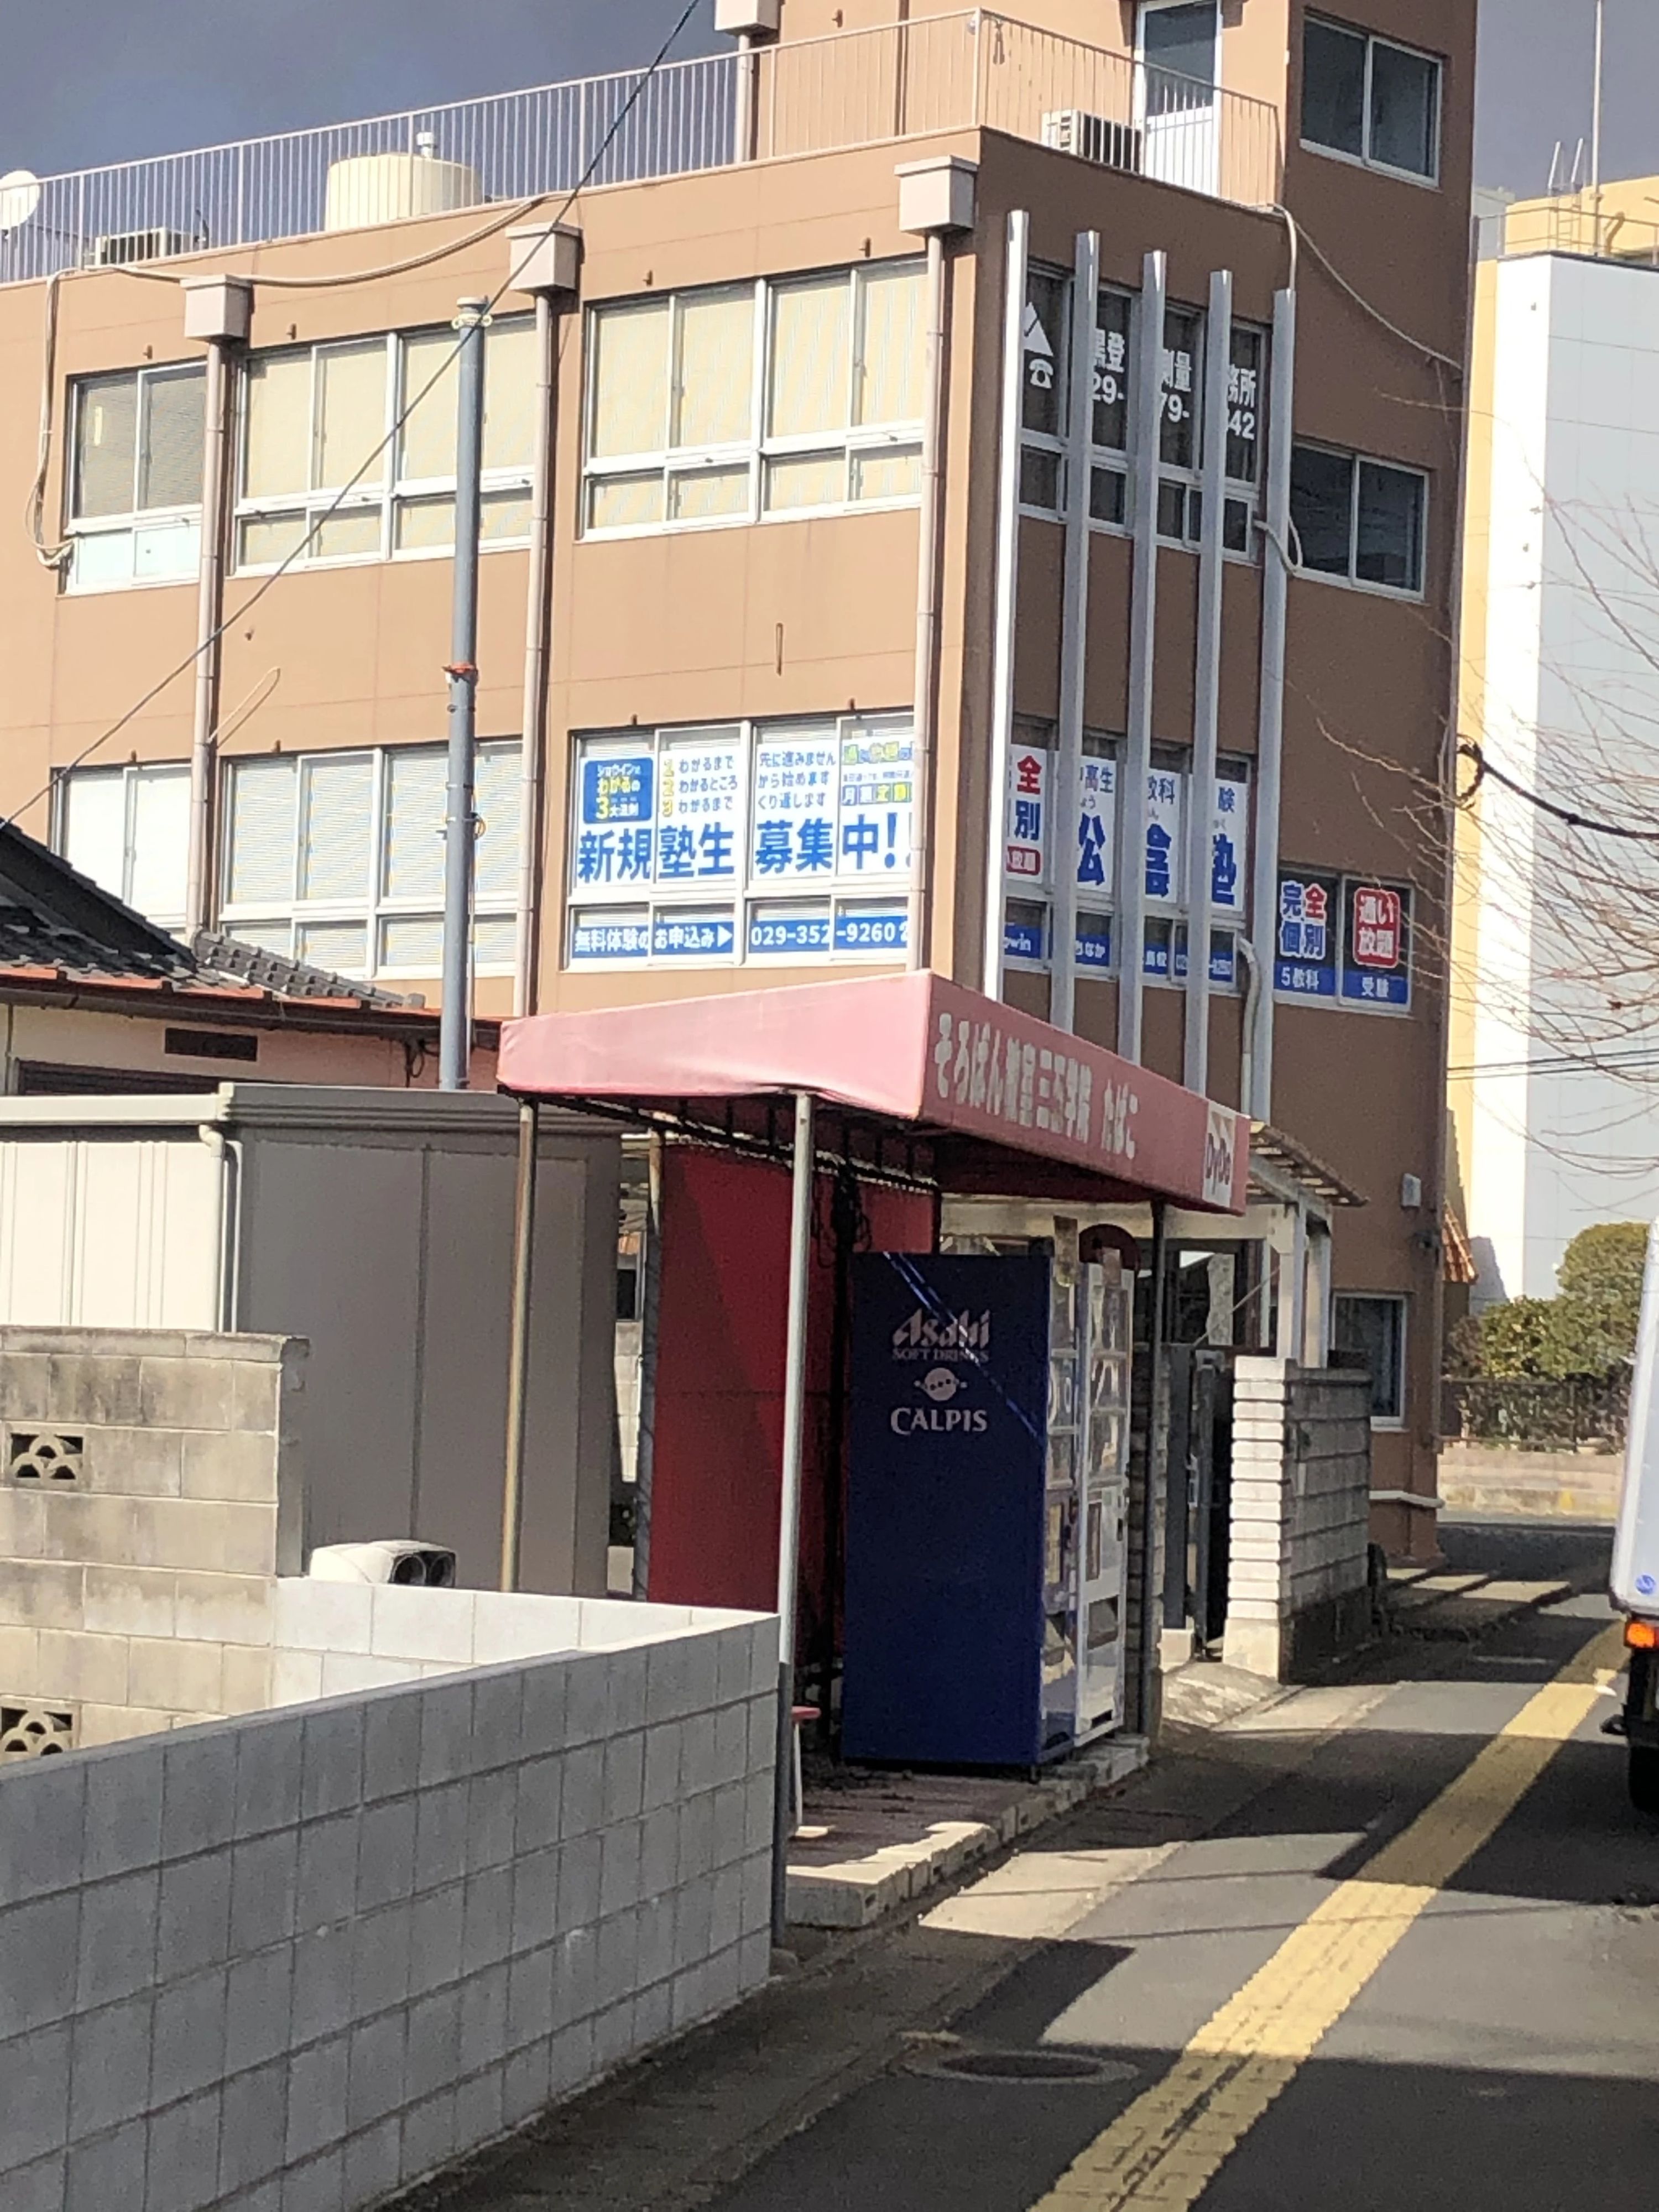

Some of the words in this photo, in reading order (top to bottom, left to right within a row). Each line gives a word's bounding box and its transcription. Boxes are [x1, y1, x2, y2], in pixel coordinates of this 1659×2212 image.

[892, 1308, 990, 1349] Asahi
[893, 1348, 931, 1361] SOFT
[934, 1348, 990, 1363] DRINS
[891, 1407, 988, 1436] CALPIS
